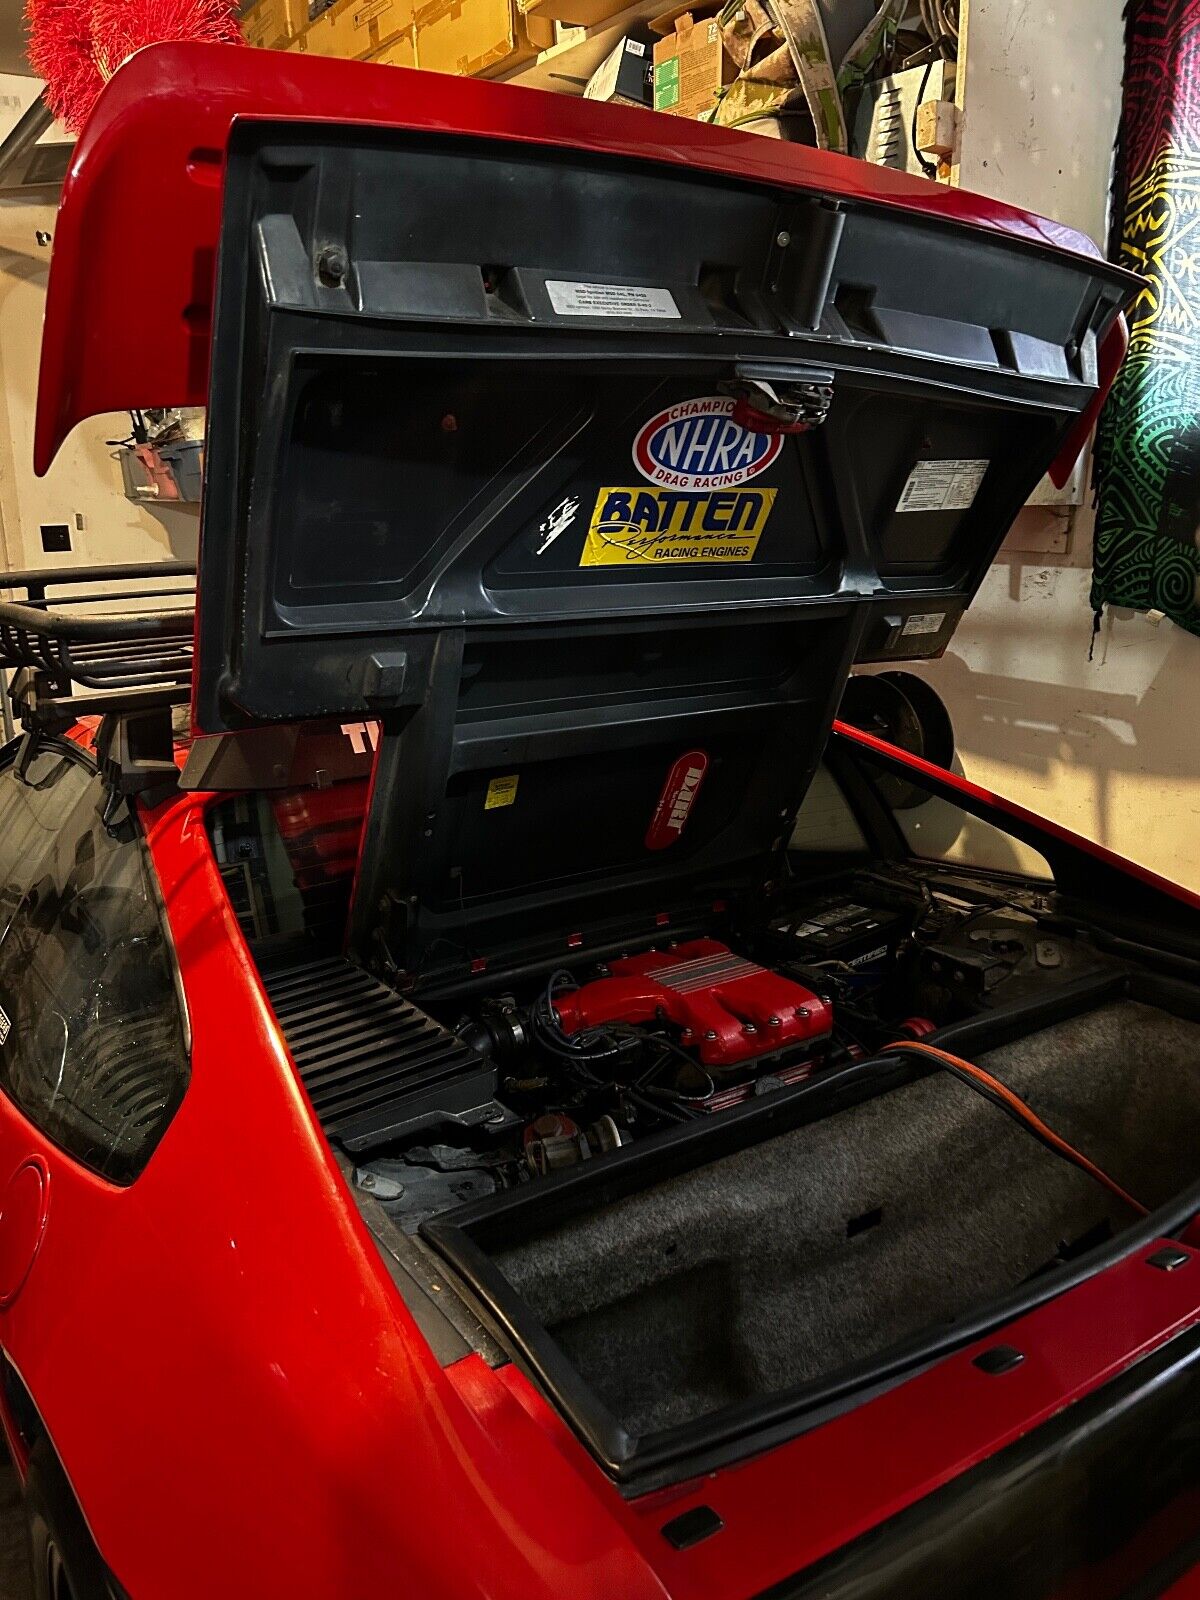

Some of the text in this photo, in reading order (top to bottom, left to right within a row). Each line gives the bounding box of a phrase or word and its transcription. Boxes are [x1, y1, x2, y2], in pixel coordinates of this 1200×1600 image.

[670, 401, 736, 420] CHAMPIO
[658, 418, 757, 472] NHRA
[655, 468, 743, 488] DRAG RACING
[597, 491, 763, 534] BATTEN
[592, 521, 756, 560] Performance
[654, 546, 750, 559] RACING ENGINES
